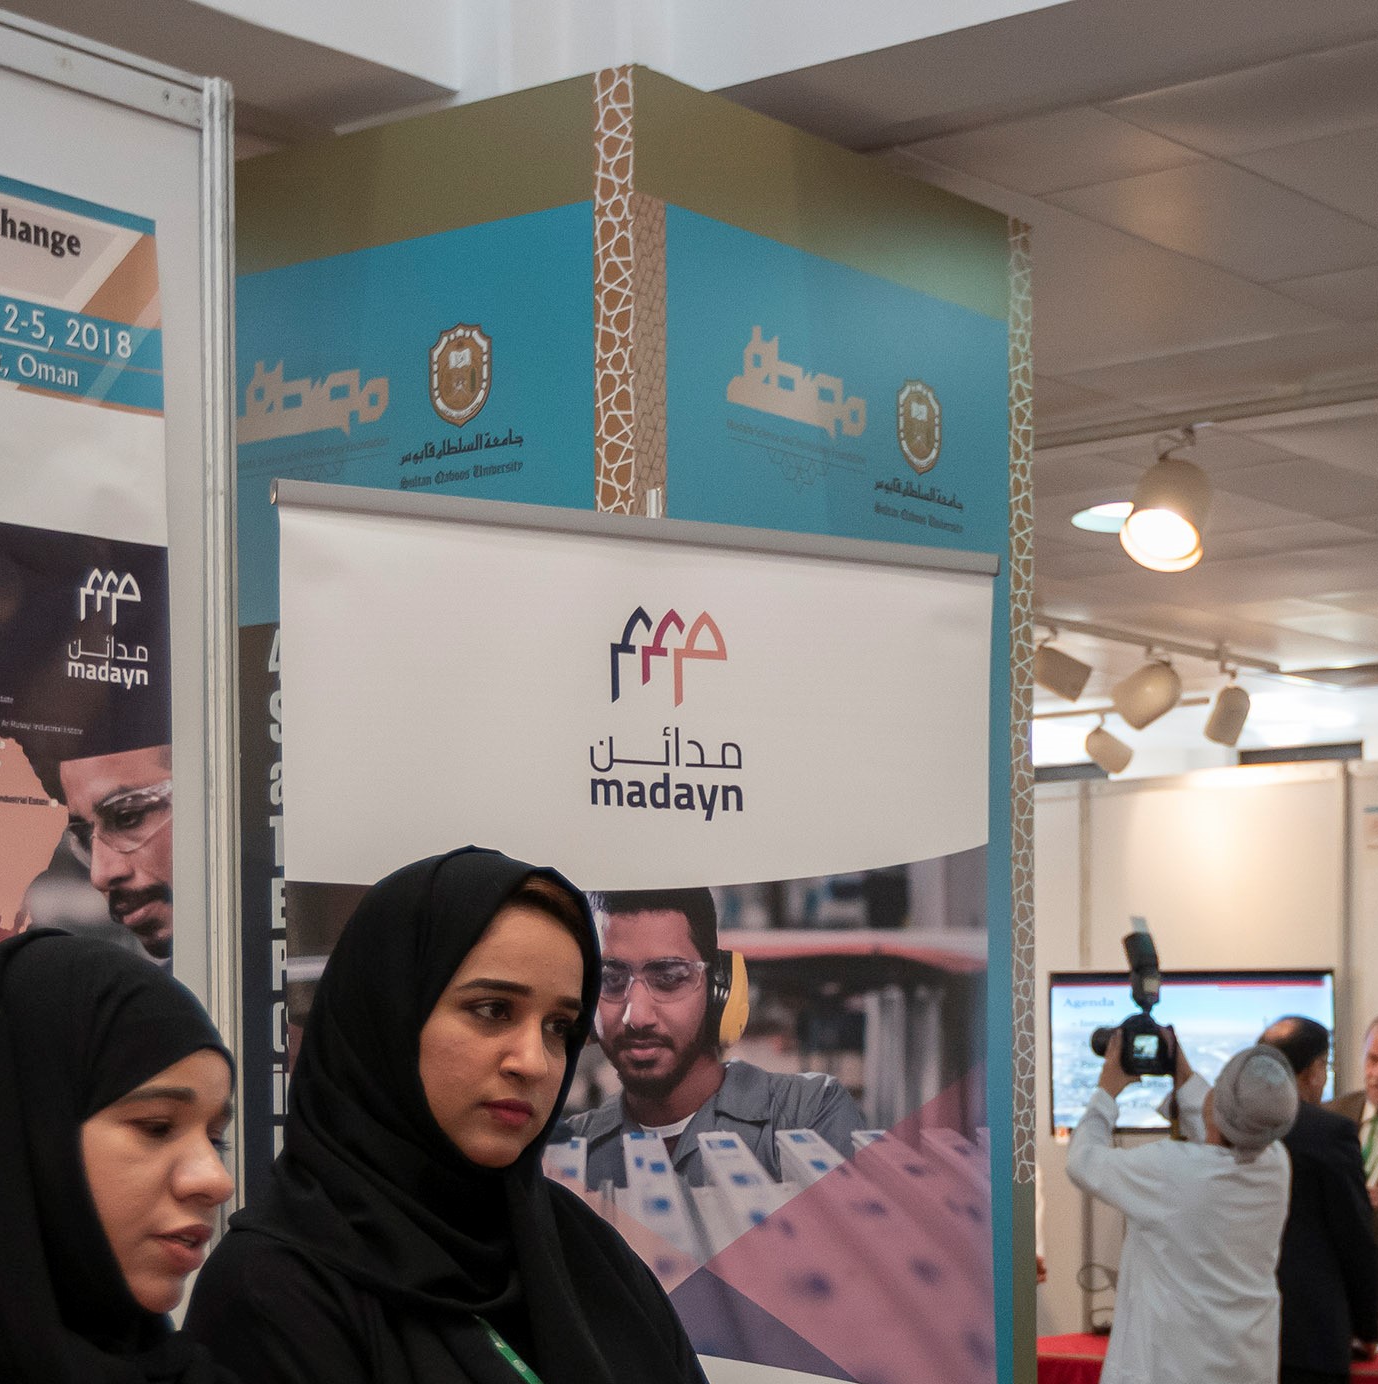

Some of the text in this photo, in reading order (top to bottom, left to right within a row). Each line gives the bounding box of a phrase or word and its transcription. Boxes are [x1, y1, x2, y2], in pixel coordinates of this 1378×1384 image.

[4, 303, 55, 348] 2-5,
[65, 317, 133, 359] 2018
[17, 354, 80, 388] Oman
[472, 459, 525, 479] University
[67, 635, 149, 663] مدائن
[66, 660, 150, 690] madayn
[589, 726, 743, 773] مدائن
[590, 772, 744, 822] madayn
[1063, 996, 1116, 1008] Agenda
